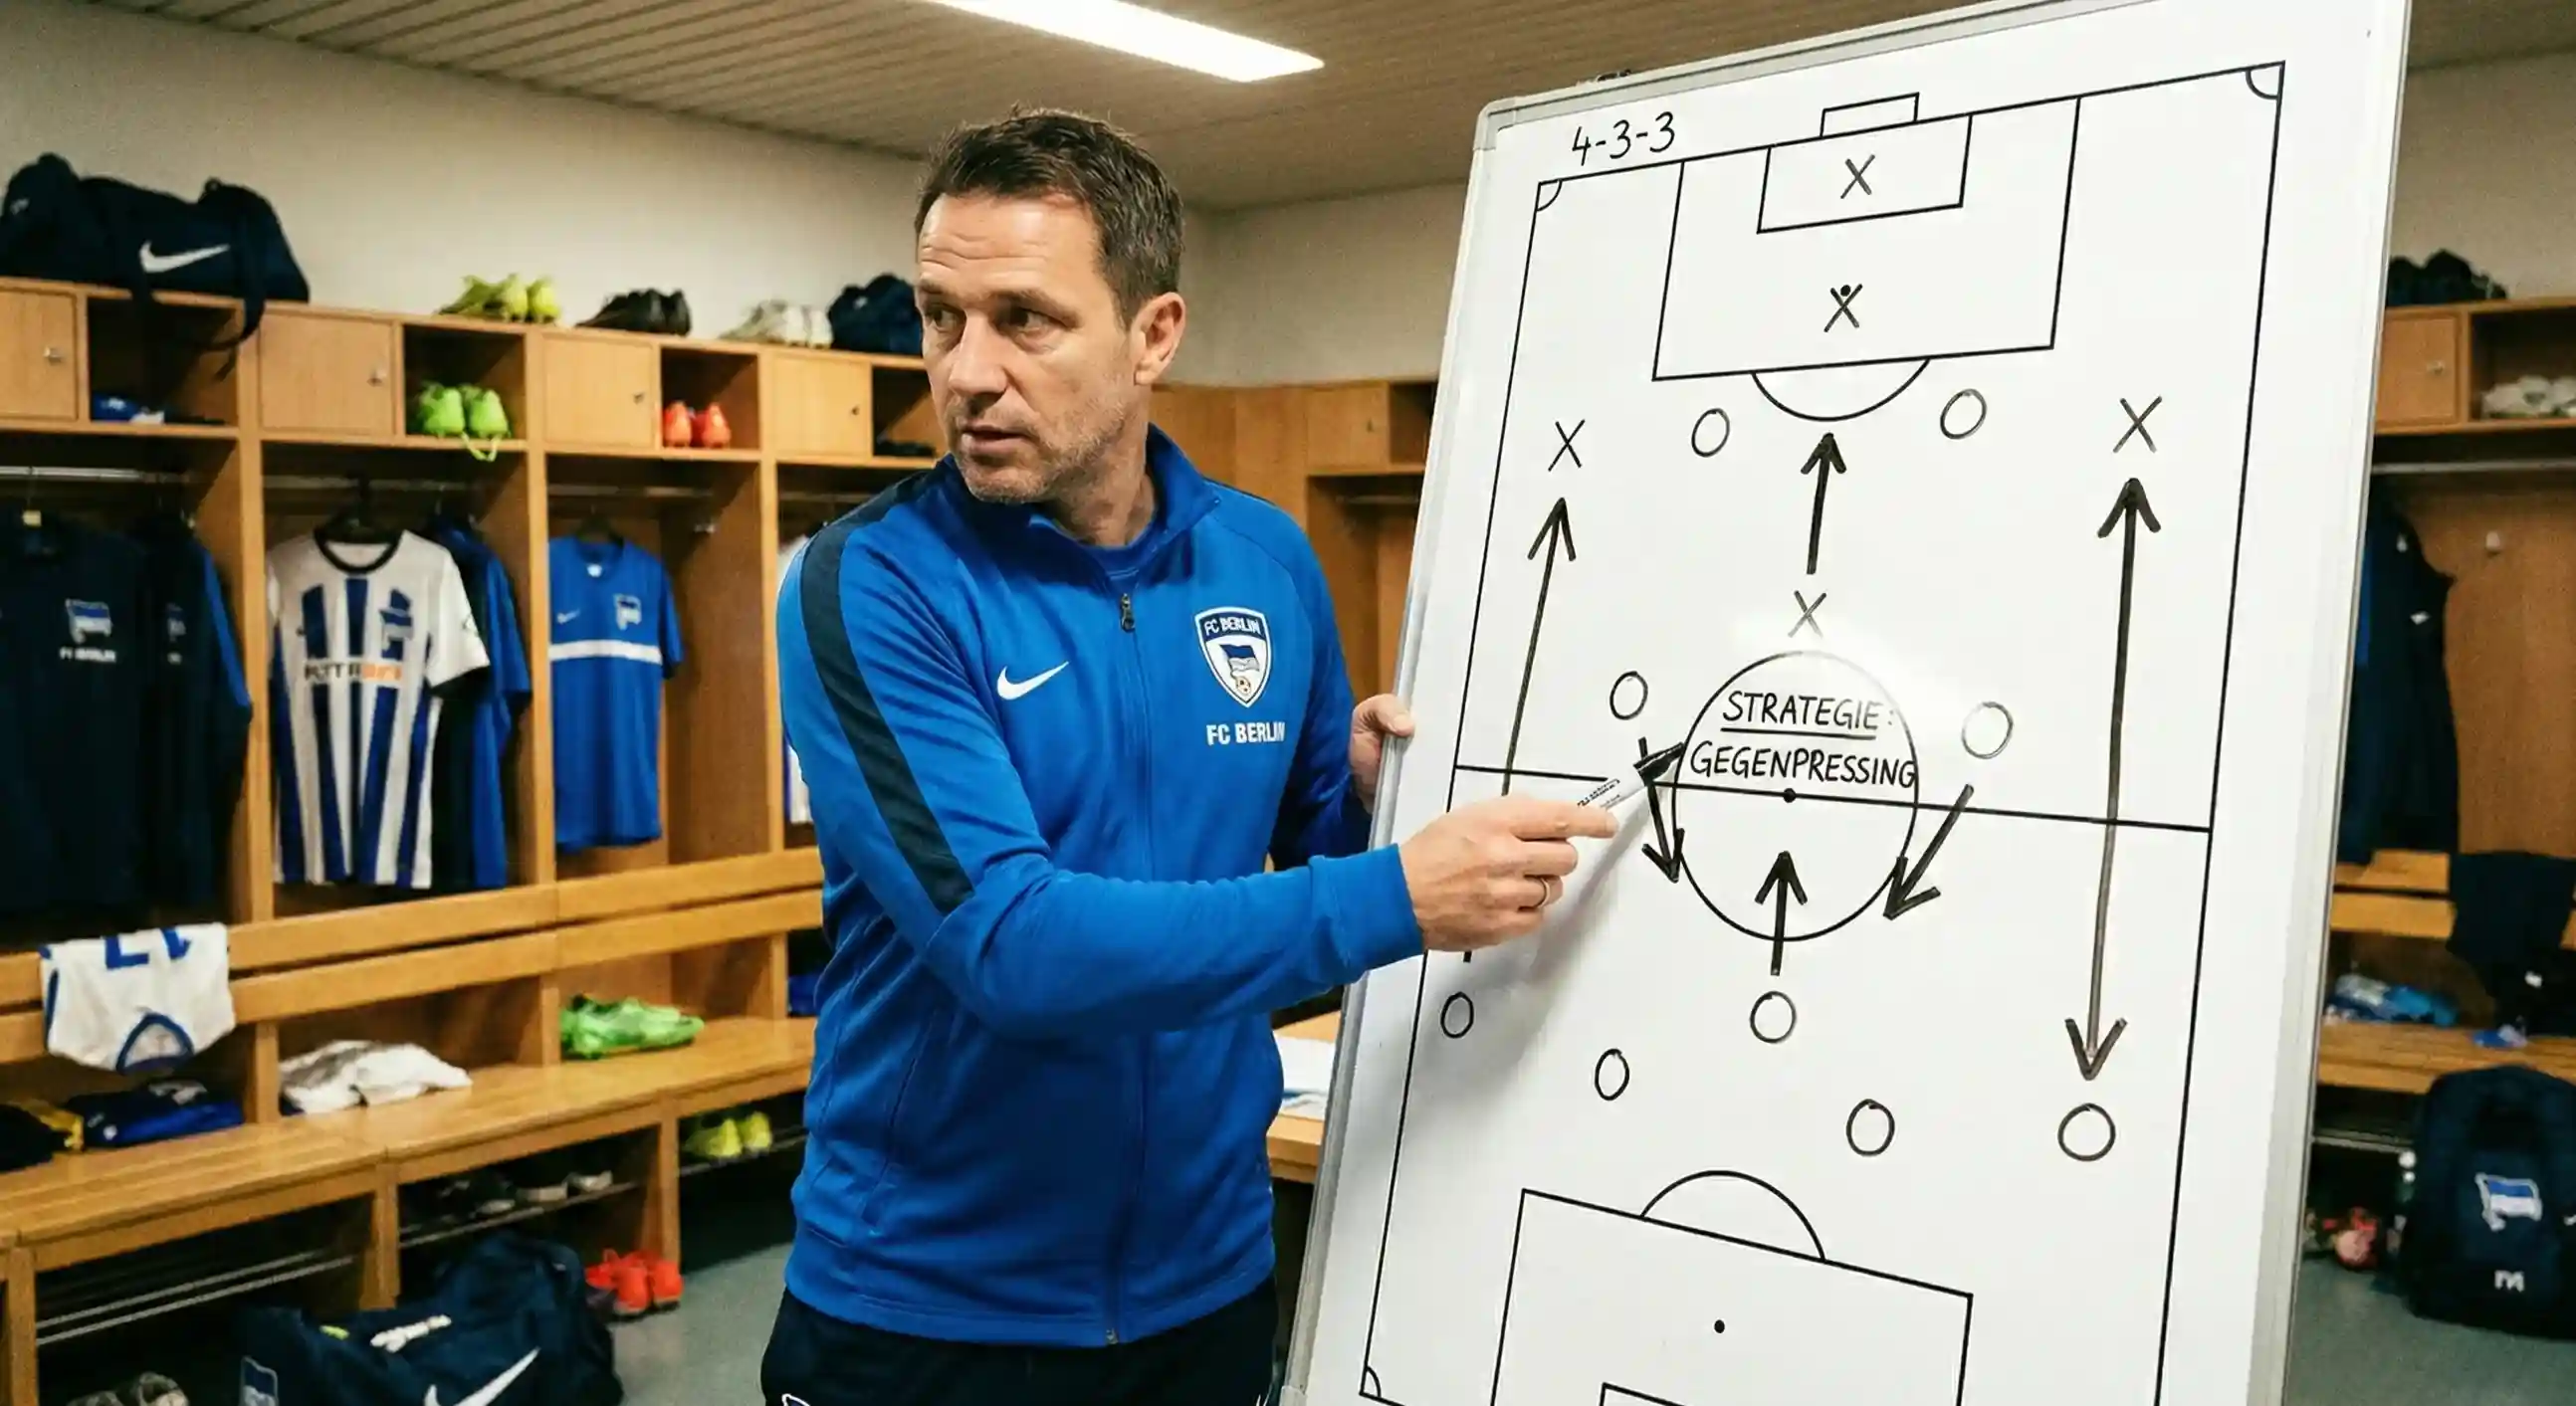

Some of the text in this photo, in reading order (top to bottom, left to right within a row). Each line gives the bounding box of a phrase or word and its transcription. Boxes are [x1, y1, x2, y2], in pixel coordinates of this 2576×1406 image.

[1571, 110, 1676, 167] 4-3-3
[1203, 616, 1262, 636] FC BERLIN
[1722, 690, 1895, 730] STRATEGIE:
[1205, 720, 1286, 746] FC BERLIN
[1689, 740, 1917, 788] GEGENPRESSING
